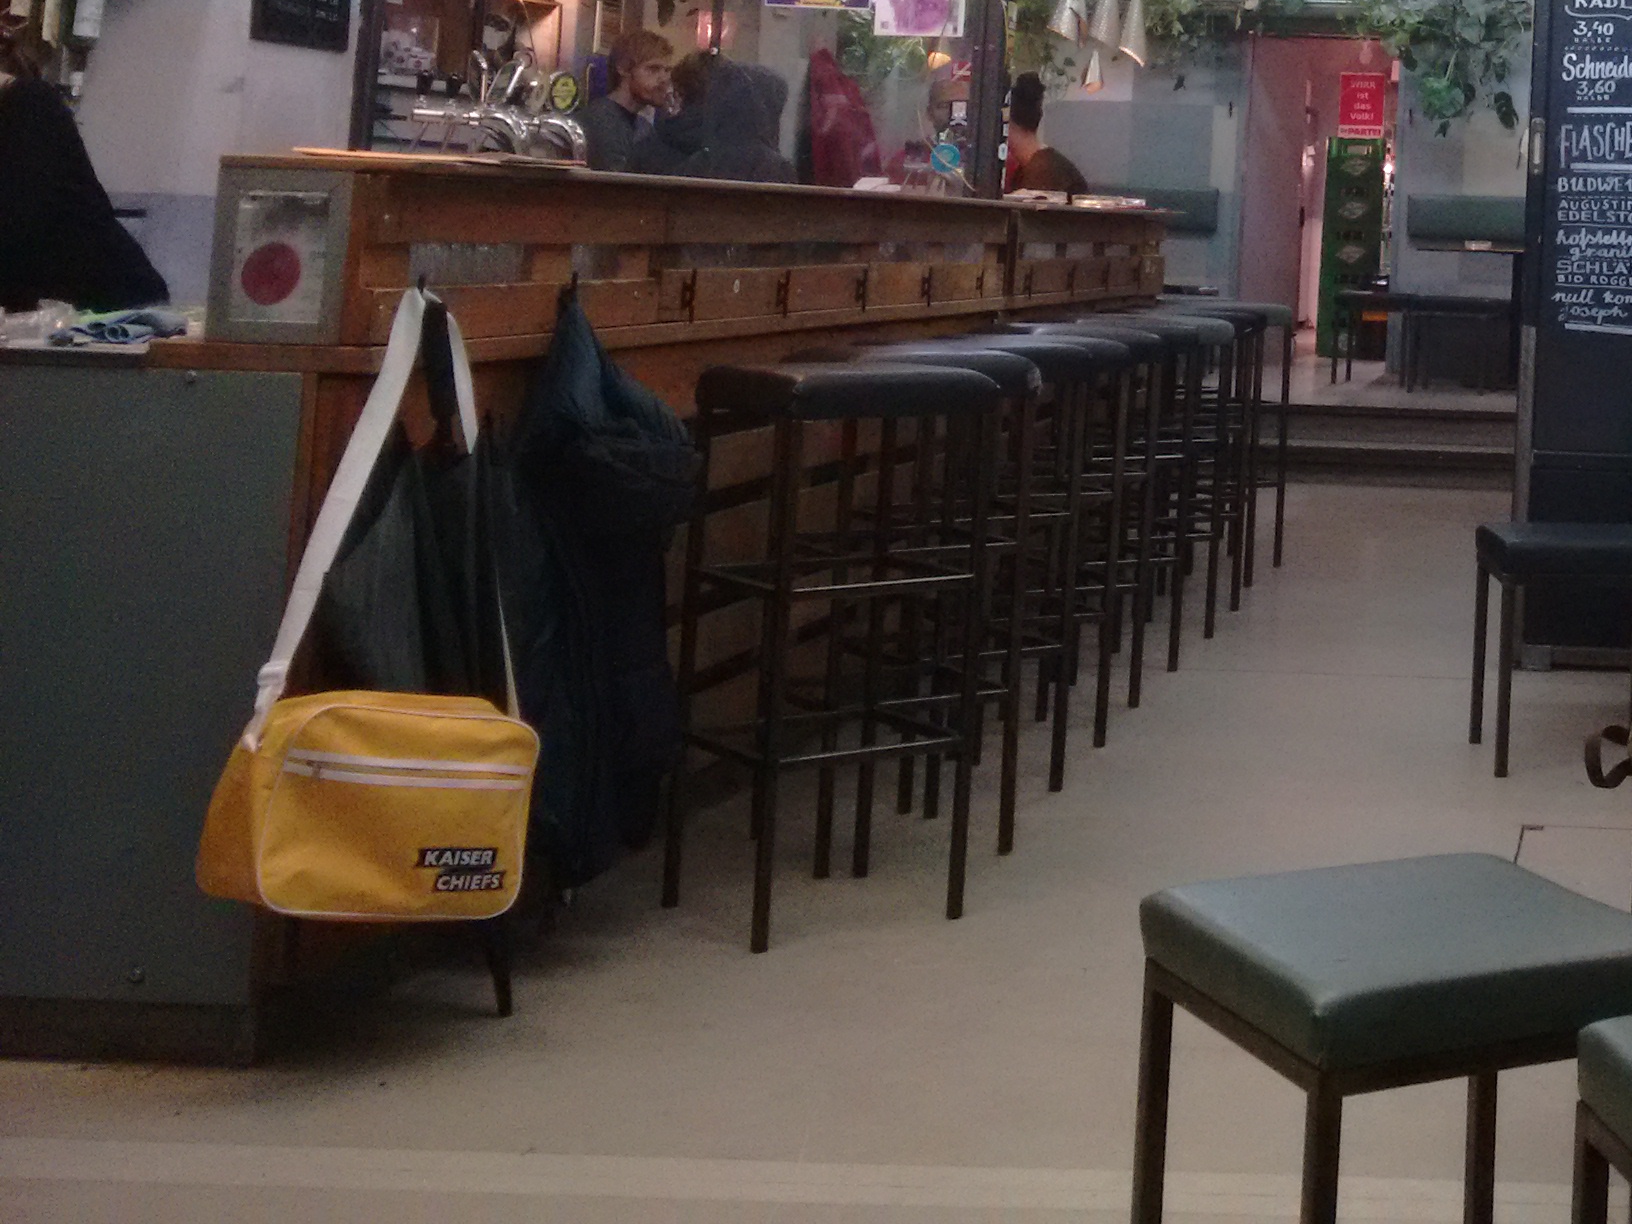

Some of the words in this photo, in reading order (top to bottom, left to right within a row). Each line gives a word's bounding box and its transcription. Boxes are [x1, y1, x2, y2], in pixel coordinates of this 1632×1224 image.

[1572, 20, 1615, 38] 3,40
[1575, 79, 1617, 96] 3,60
[1353, 102, 1372, 111] das
[1556, 274, 1584, 284] BIO
[1551, 288, 1596, 305] null
[423, 849, 494, 866] KAISER
[436, 873, 501, 891] CHIEFS
